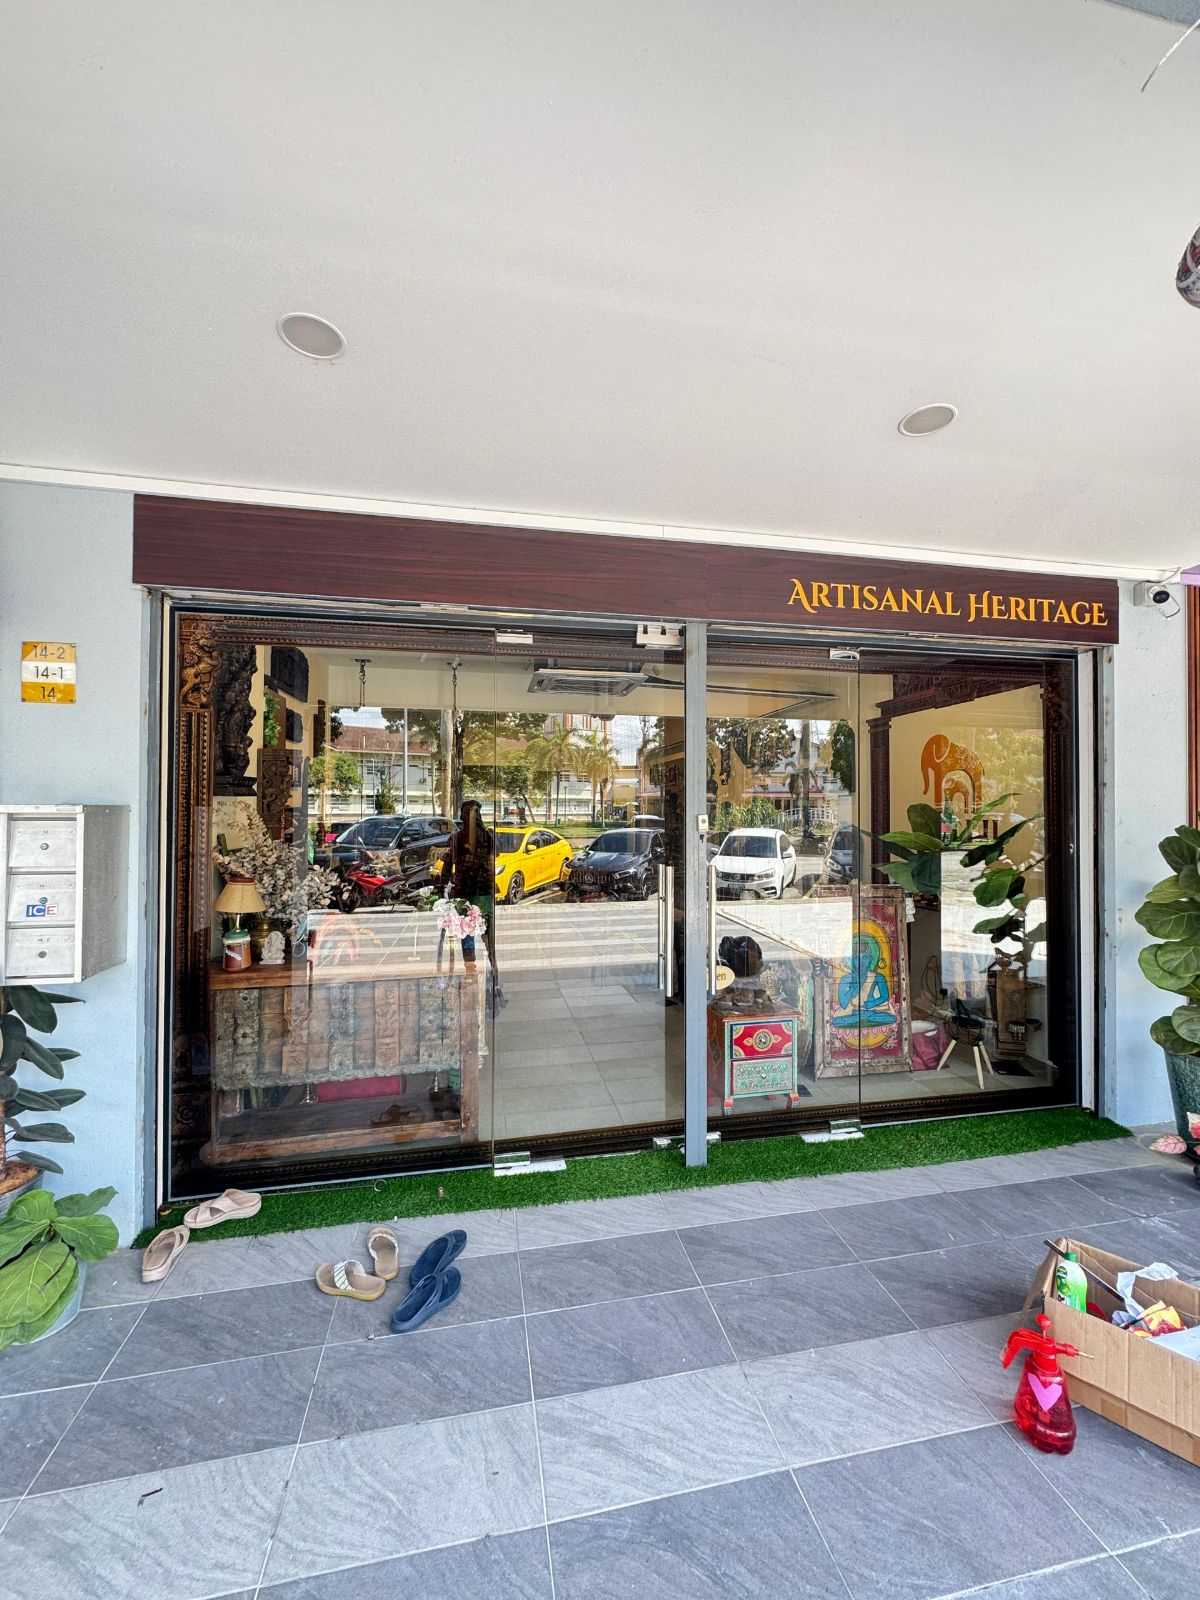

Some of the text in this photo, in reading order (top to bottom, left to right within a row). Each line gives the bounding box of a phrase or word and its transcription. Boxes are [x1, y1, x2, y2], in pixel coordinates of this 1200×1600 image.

[787, 578, 1108, 627] ARTISANAL HERITAGE
[33, 645, 66, 660] 14-2
[34, 665, 64, 680] 14-1
[41, 686, 57, 700] 14
[28, 905, 57, 917] ICE
